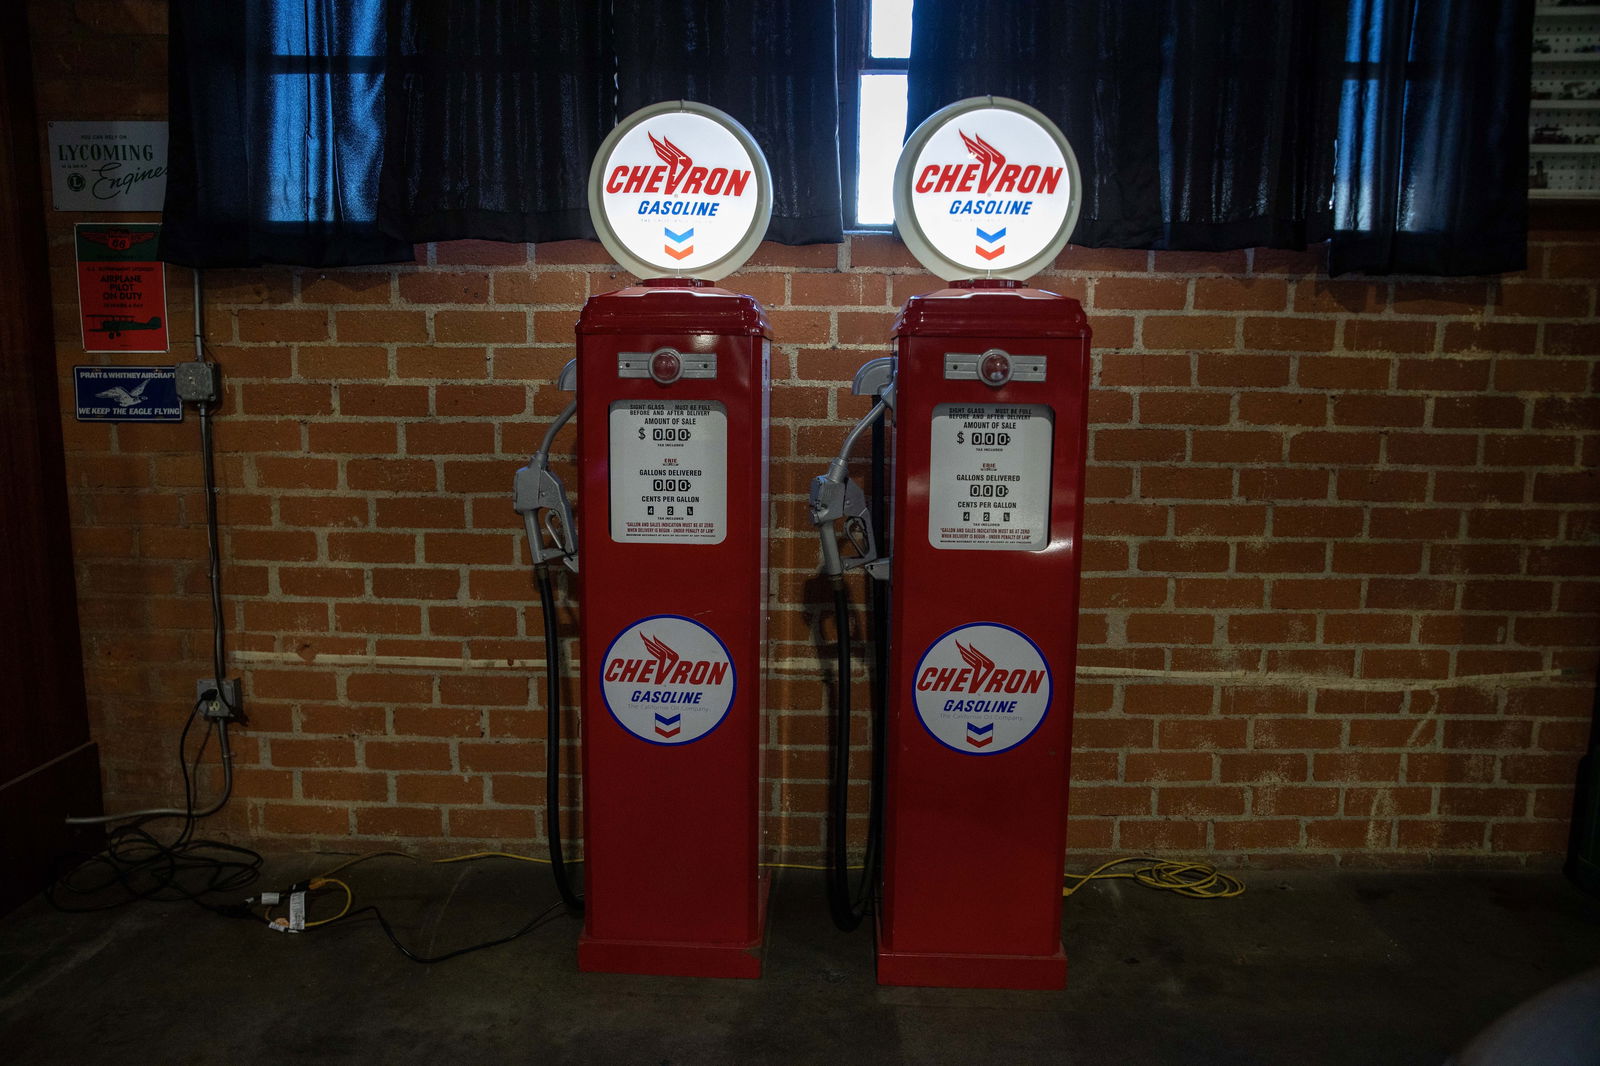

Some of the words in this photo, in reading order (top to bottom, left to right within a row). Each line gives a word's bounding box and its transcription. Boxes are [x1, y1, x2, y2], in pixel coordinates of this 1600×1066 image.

[58, 144, 153, 161] LYCOMING
[606, 152, 752, 197] CHEVRON
[915, 152, 1064, 195] CHEVRON
[638, 200, 720, 217] GASOLINE
[949, 200, 1033, 215] GASOLINE
[101, 275, 142, 283] AIRPLANE
[109, 283, 135, 291] PILOT
[102, 292, 117, 300] ON
[119, 292, 143, 300] DUTY
[79, 407, 91, 415] WE
[91, 407, 111, 415] KEEP
[112, 407, 127, 415] THE
[129, 407, 152, 415] EAGLE
[154, 407, 180, 415] FLYING
[638, 427, 646, 440] $
[957, 431, 965, 444] $
[604, 649, 729, 685] CHEVRON
[917, 657, 1046, 694] CHEVRON
[631, 690, 703, 704] GASOLINE
[943, 699, 1018, 713] GASOLINE
